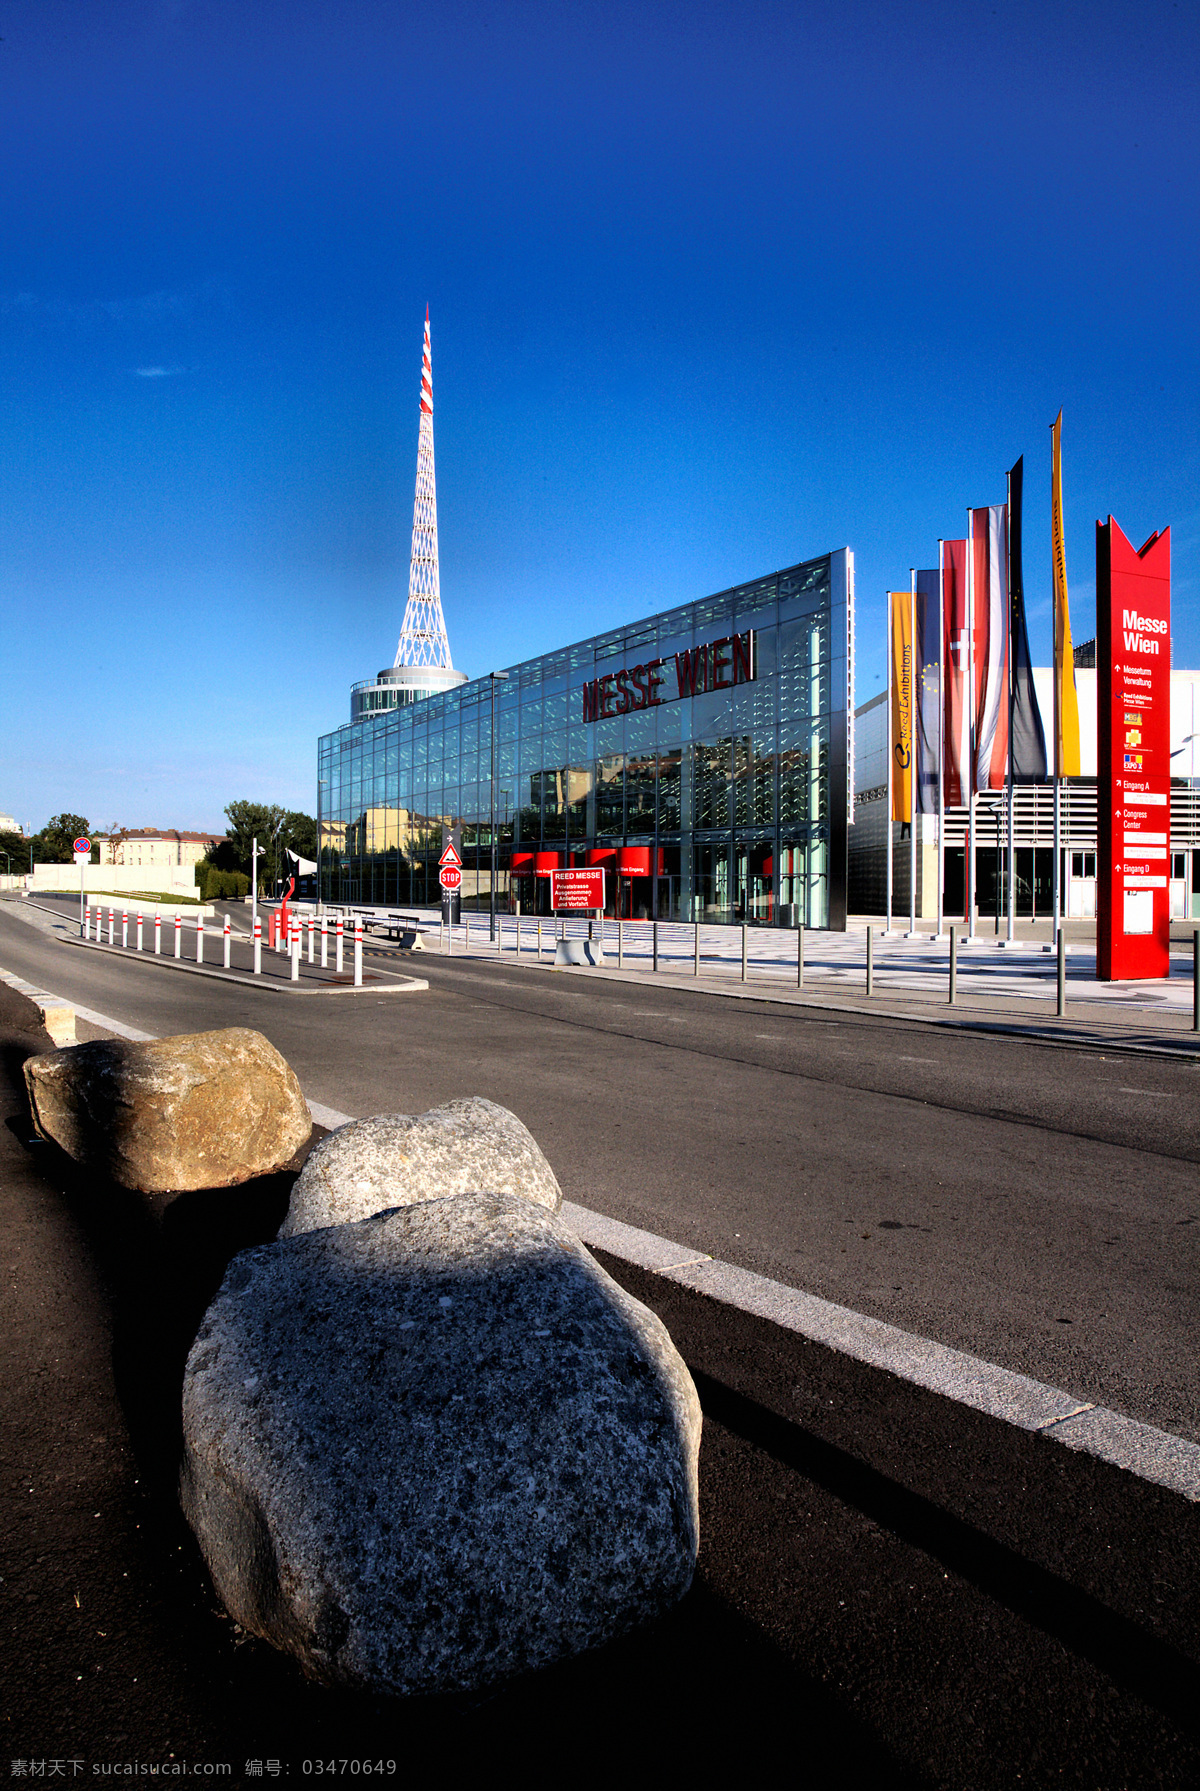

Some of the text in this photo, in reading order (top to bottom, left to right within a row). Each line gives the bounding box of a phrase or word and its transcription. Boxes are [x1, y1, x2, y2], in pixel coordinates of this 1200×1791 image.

[1123, 609, 1168, 634] Messe
[1123, 631, 1160, 655] Wien
[1123, 664, 1152, 676] Messeturm
[583, 629, 755, 724] MESSE WIEN
[1123, 675, 1152, 689] Verwaltung
[899, 644, 911, 739] Reed Exhibitions
[1124, 780, 1150, 791] Eingang A
[1124, 809, 1147, 820] Congress
[1124, 820, 1141, 829] Center
[1124, 864, 1150, 875] Eingang D
[442, 873, 459, 882] STOP
